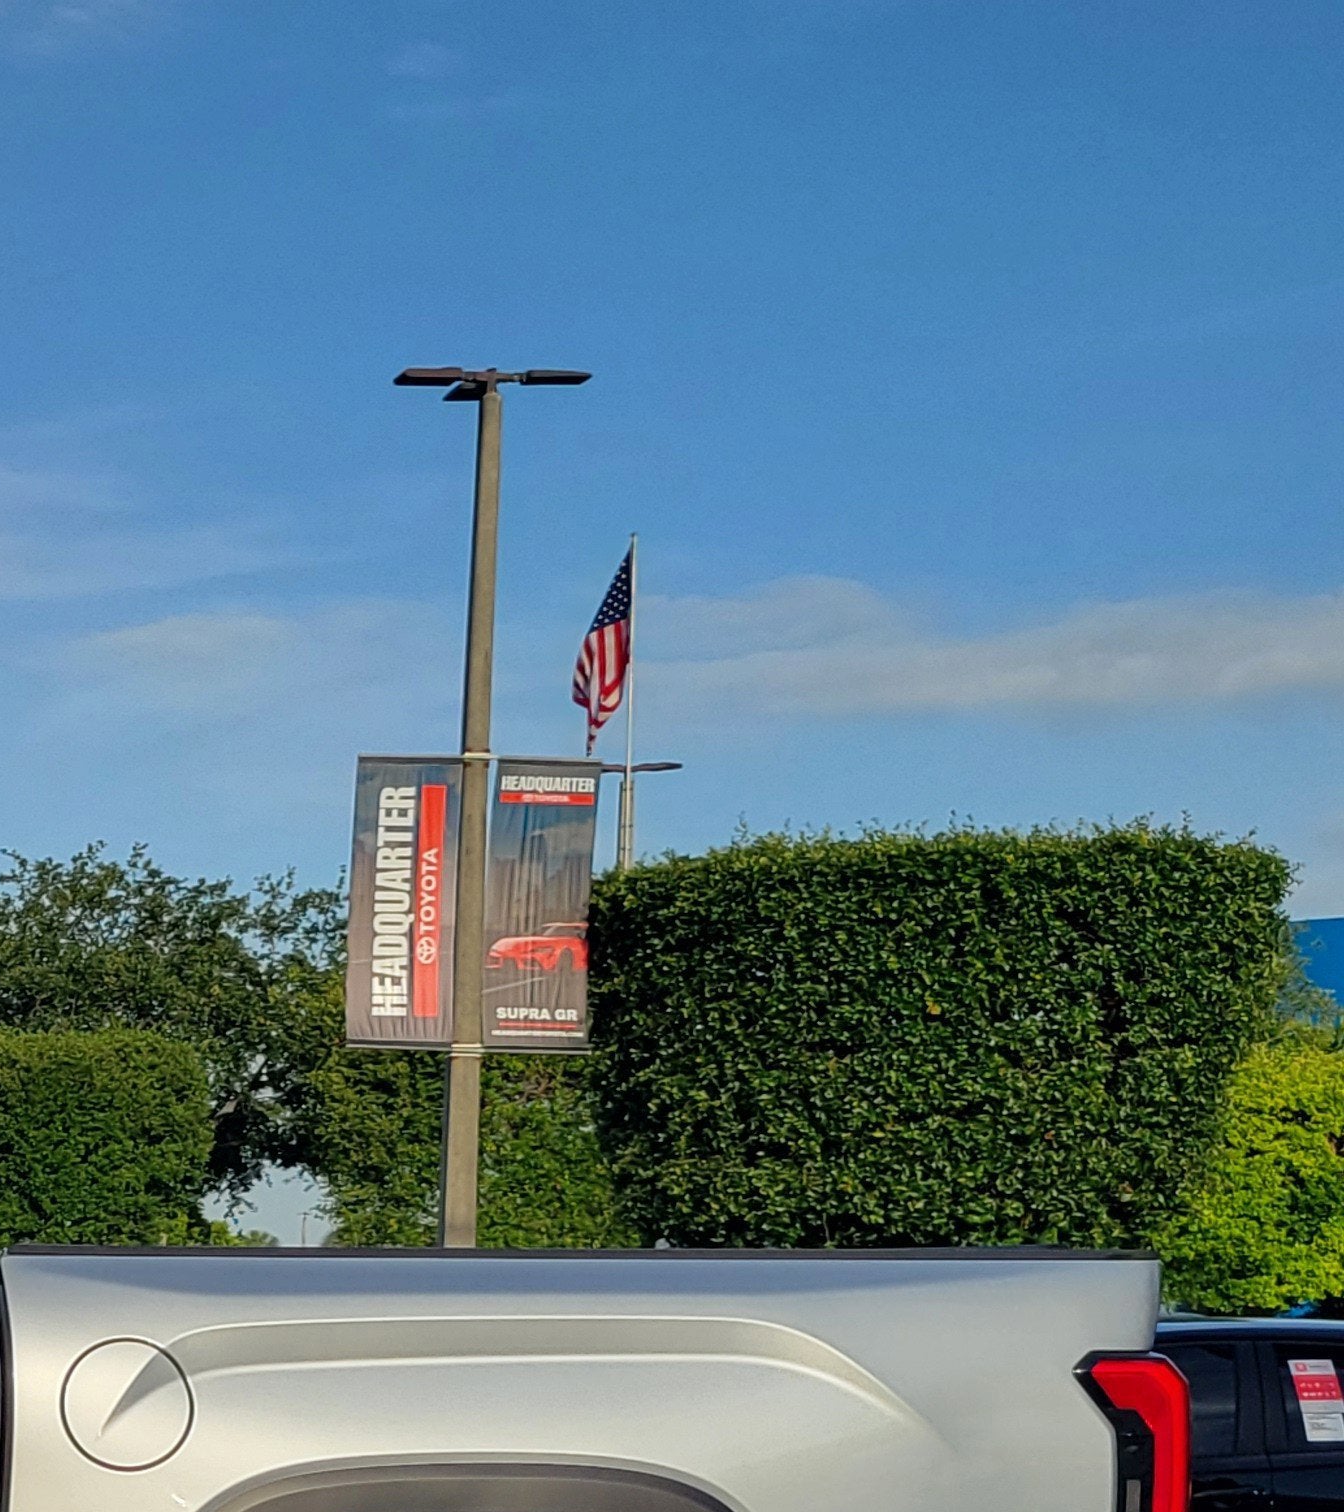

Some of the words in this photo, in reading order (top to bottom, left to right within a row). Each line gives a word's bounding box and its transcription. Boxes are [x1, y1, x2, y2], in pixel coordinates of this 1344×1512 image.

[501, 775, 595, 793] HEADQUARTER
[371, 786, 416, 1017] HEADQUARTER
[420, 848, 439, 935] TOYOTA
[496, 1007, 551, 1020] SUPRA
[554, 1009, 578, 1021] GR
